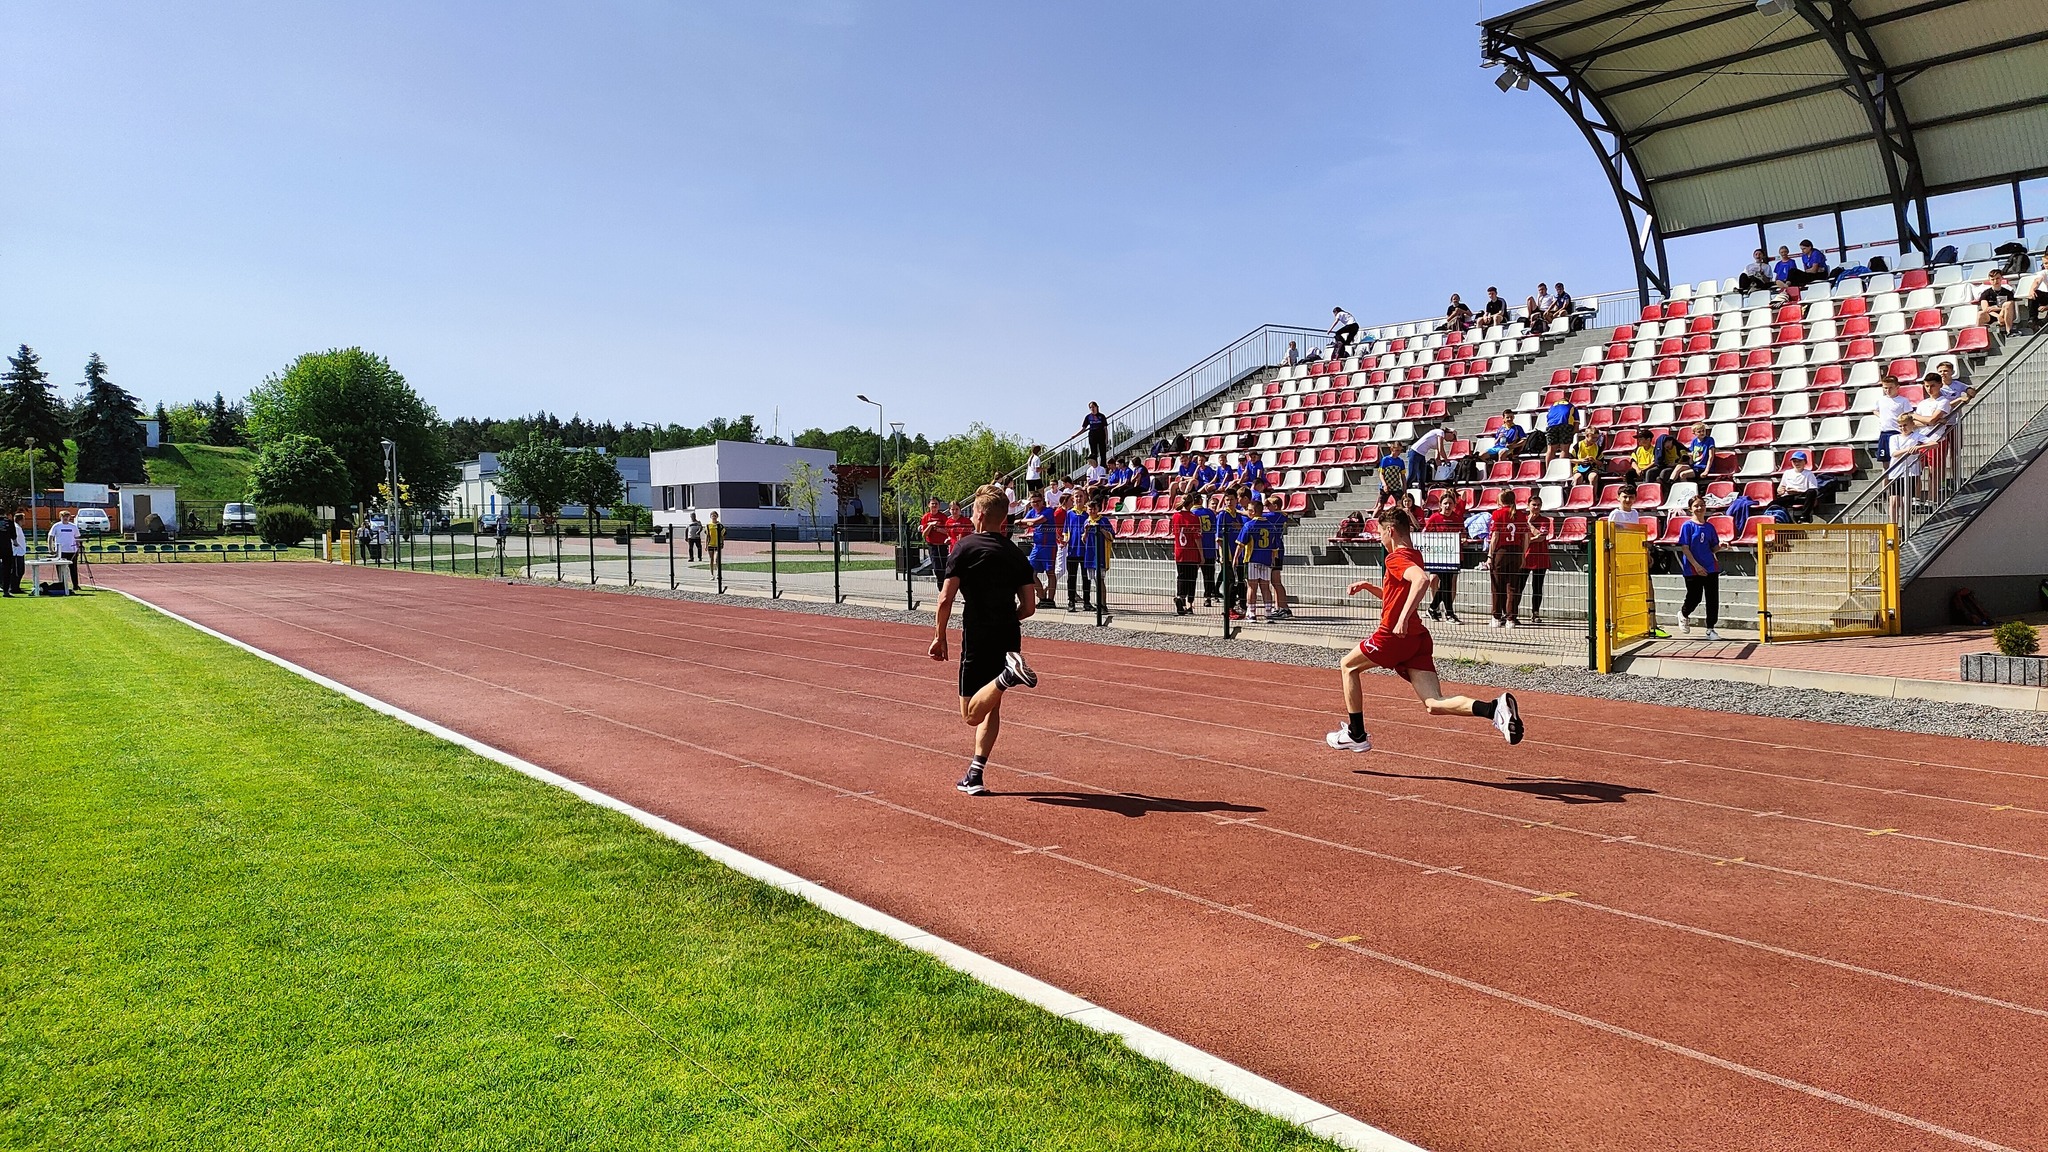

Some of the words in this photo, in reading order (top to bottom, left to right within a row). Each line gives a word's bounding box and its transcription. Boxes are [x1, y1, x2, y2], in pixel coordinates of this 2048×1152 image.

[1879, 449, 1885, 457] 3
[1179, 526, 1188, 547] 6
[1258, 527, 1270, 549] 3
[1506, 522, 1517, 542] 3
[1699, 532, 1705, 543] 8
